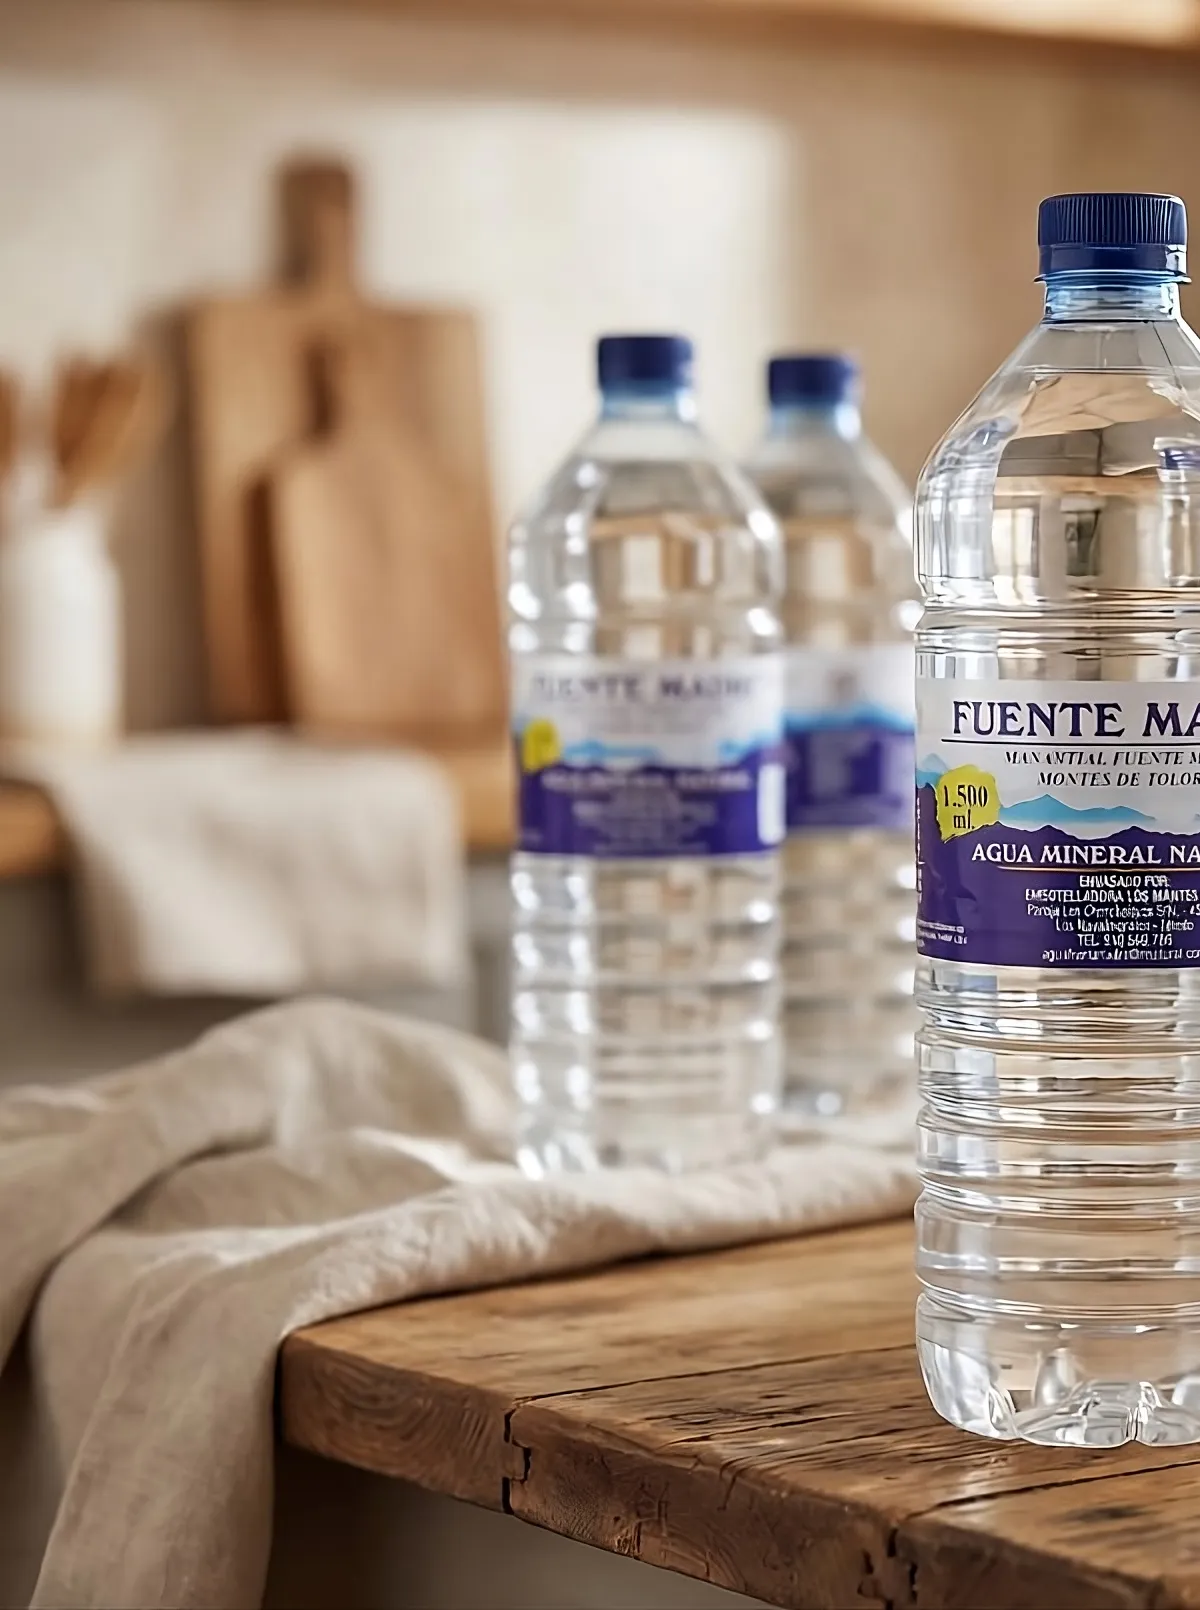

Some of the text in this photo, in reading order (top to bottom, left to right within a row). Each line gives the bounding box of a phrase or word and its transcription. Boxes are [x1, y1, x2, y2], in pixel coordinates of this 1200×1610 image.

[953, 700, 1126, 737] FUENTE
[1112, 751, 1185, 766] FUENTE
[1037, 772, 1112, 787] MONTES
[1116, 772, 1141, 787] DE
[943, 784, 989, 808] 1.500
[971, 843, 1034, 864] AGUA
[1039, 844, 1162, 865] MINERAL
